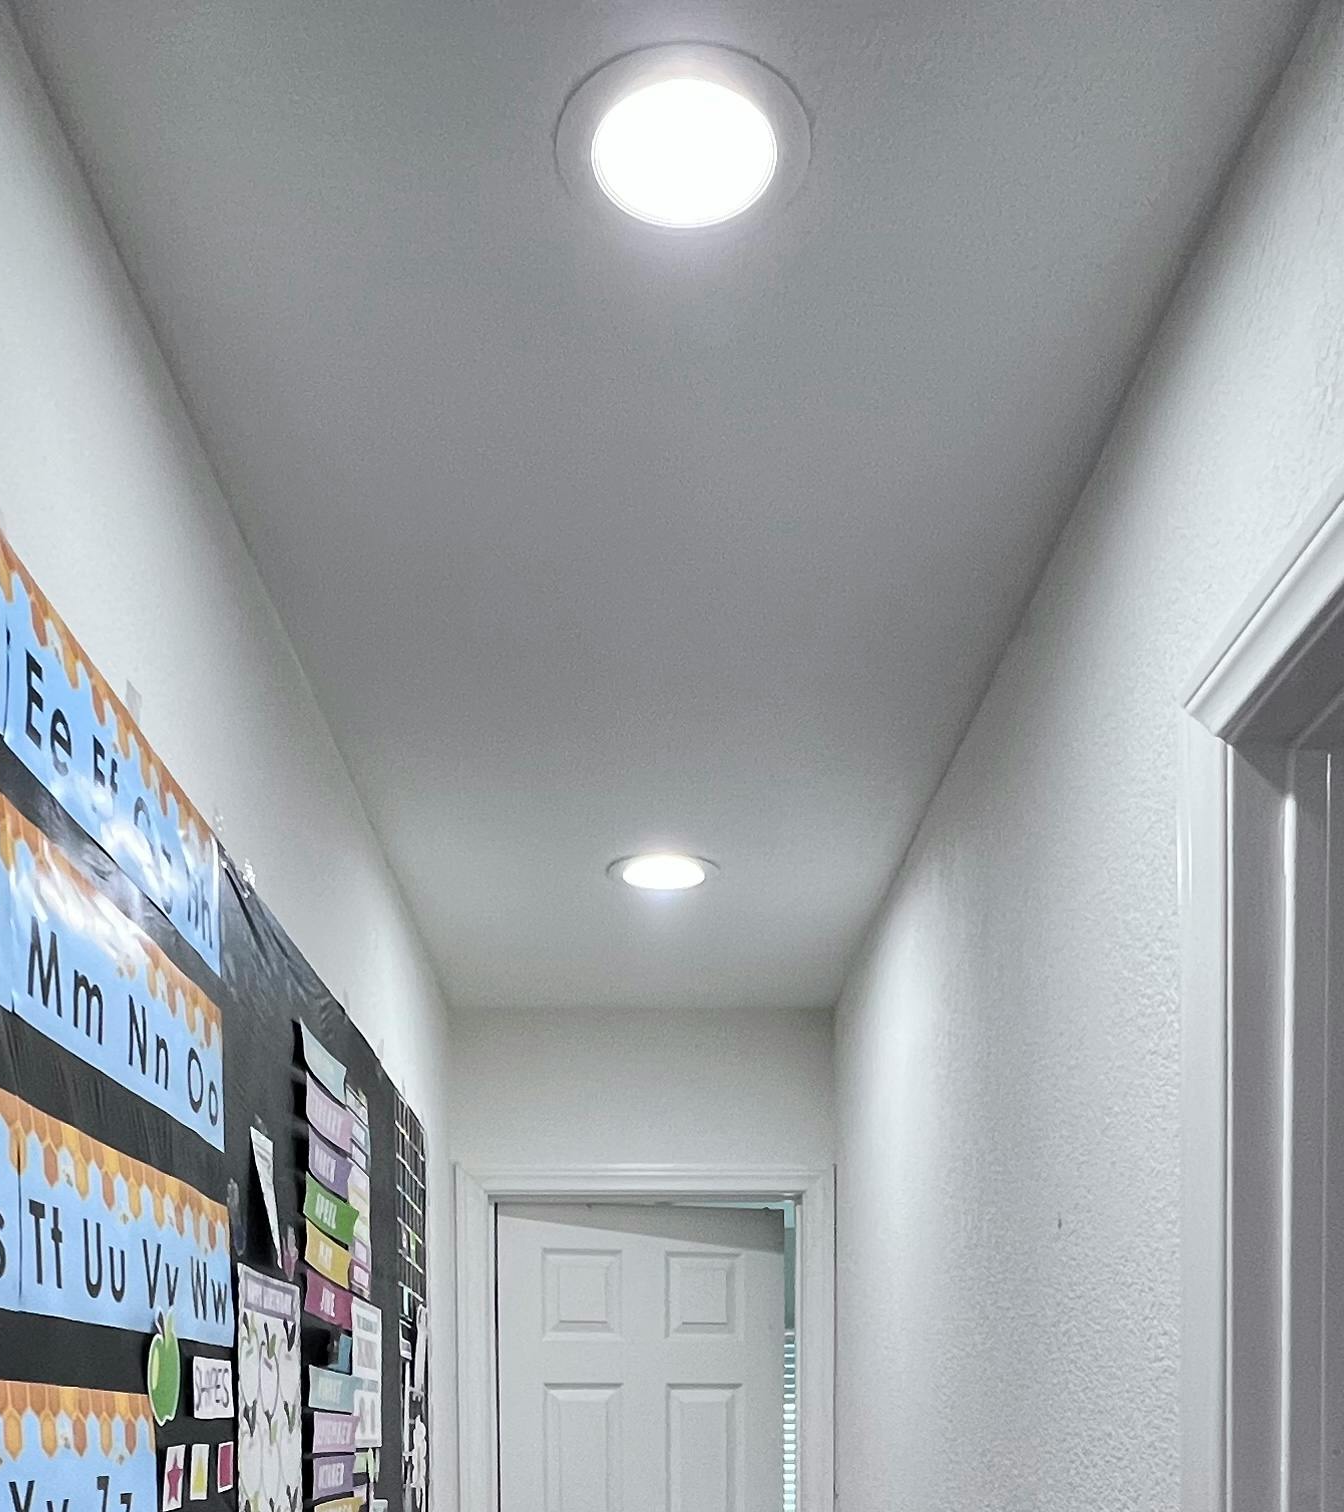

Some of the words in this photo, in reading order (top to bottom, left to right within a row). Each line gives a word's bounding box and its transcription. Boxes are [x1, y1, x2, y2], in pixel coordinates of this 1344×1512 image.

[25, 649, 72, 777] Ee
[93, 734, 118, 795] Ff
[27, 915, 104, 1046] Mm
[128, 996, 171, 1091] Nn
[187, 1049, 219, 1127] Oo
[29, 1199, 63, 1290] Tt
[83, 1218, 126, 1302] Uu
[142, 1238, 179, 1308] Vv
[190, 1254, 228, 1326] Ww
